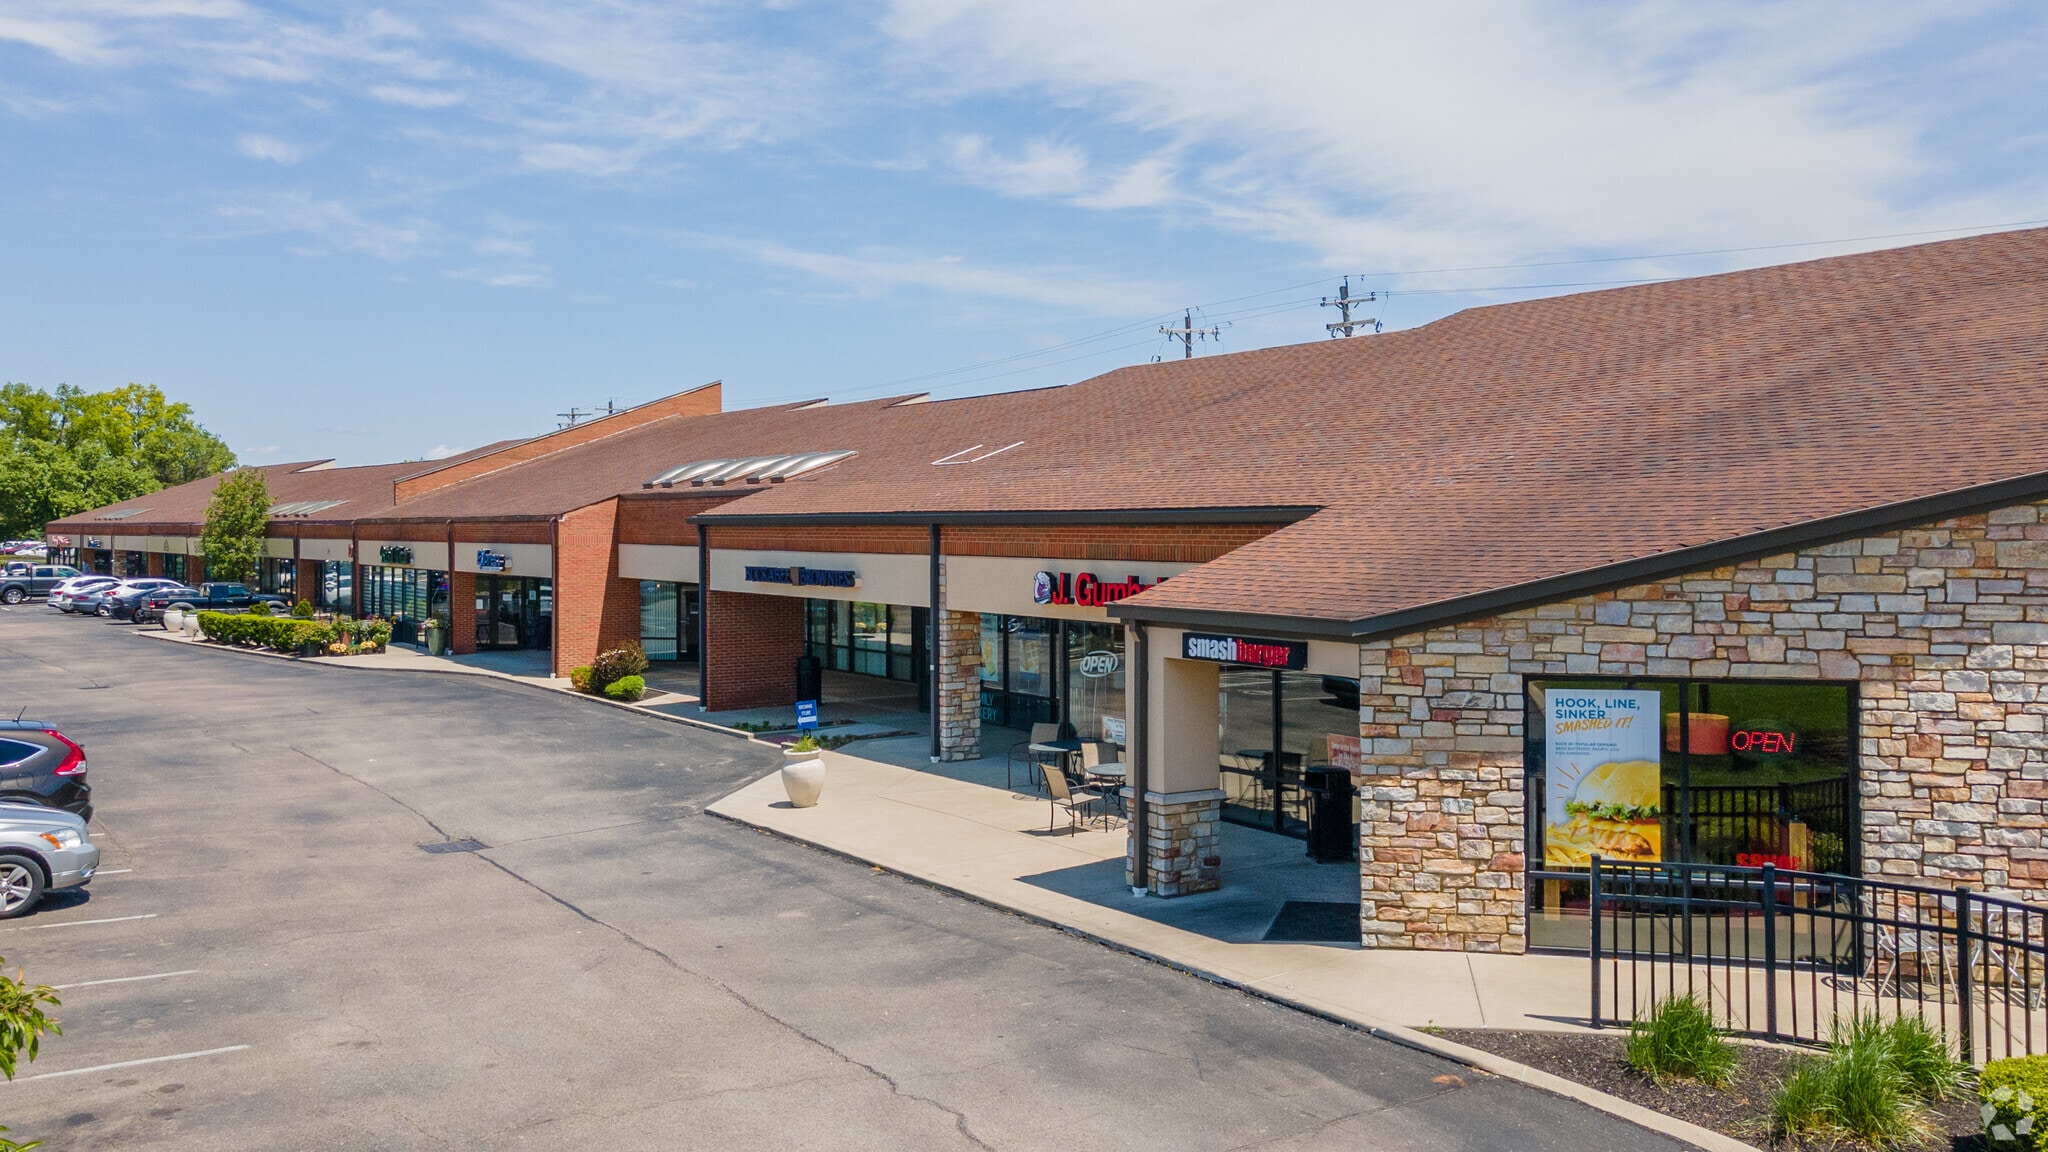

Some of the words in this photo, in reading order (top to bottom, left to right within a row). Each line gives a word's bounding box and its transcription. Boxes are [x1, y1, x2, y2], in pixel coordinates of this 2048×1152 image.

[799, 569, 854, 586] BROWNIES
[1052, 572, 1069, 604] J.
[1188, 637, 1290, 667] smashburger
[1082, 656, 1114, 673] OPEN
[1555, 698, 1600, 710] HOOK,
[1605, 699, 1640, 710] LINE,
[1555, 709, 1606, 719] SINKER
[1555, 717, 1612, 735] SMASHED
[1615, 716, 1634, 729] IT!
[1732, 730, 1795, 752] OPEN
